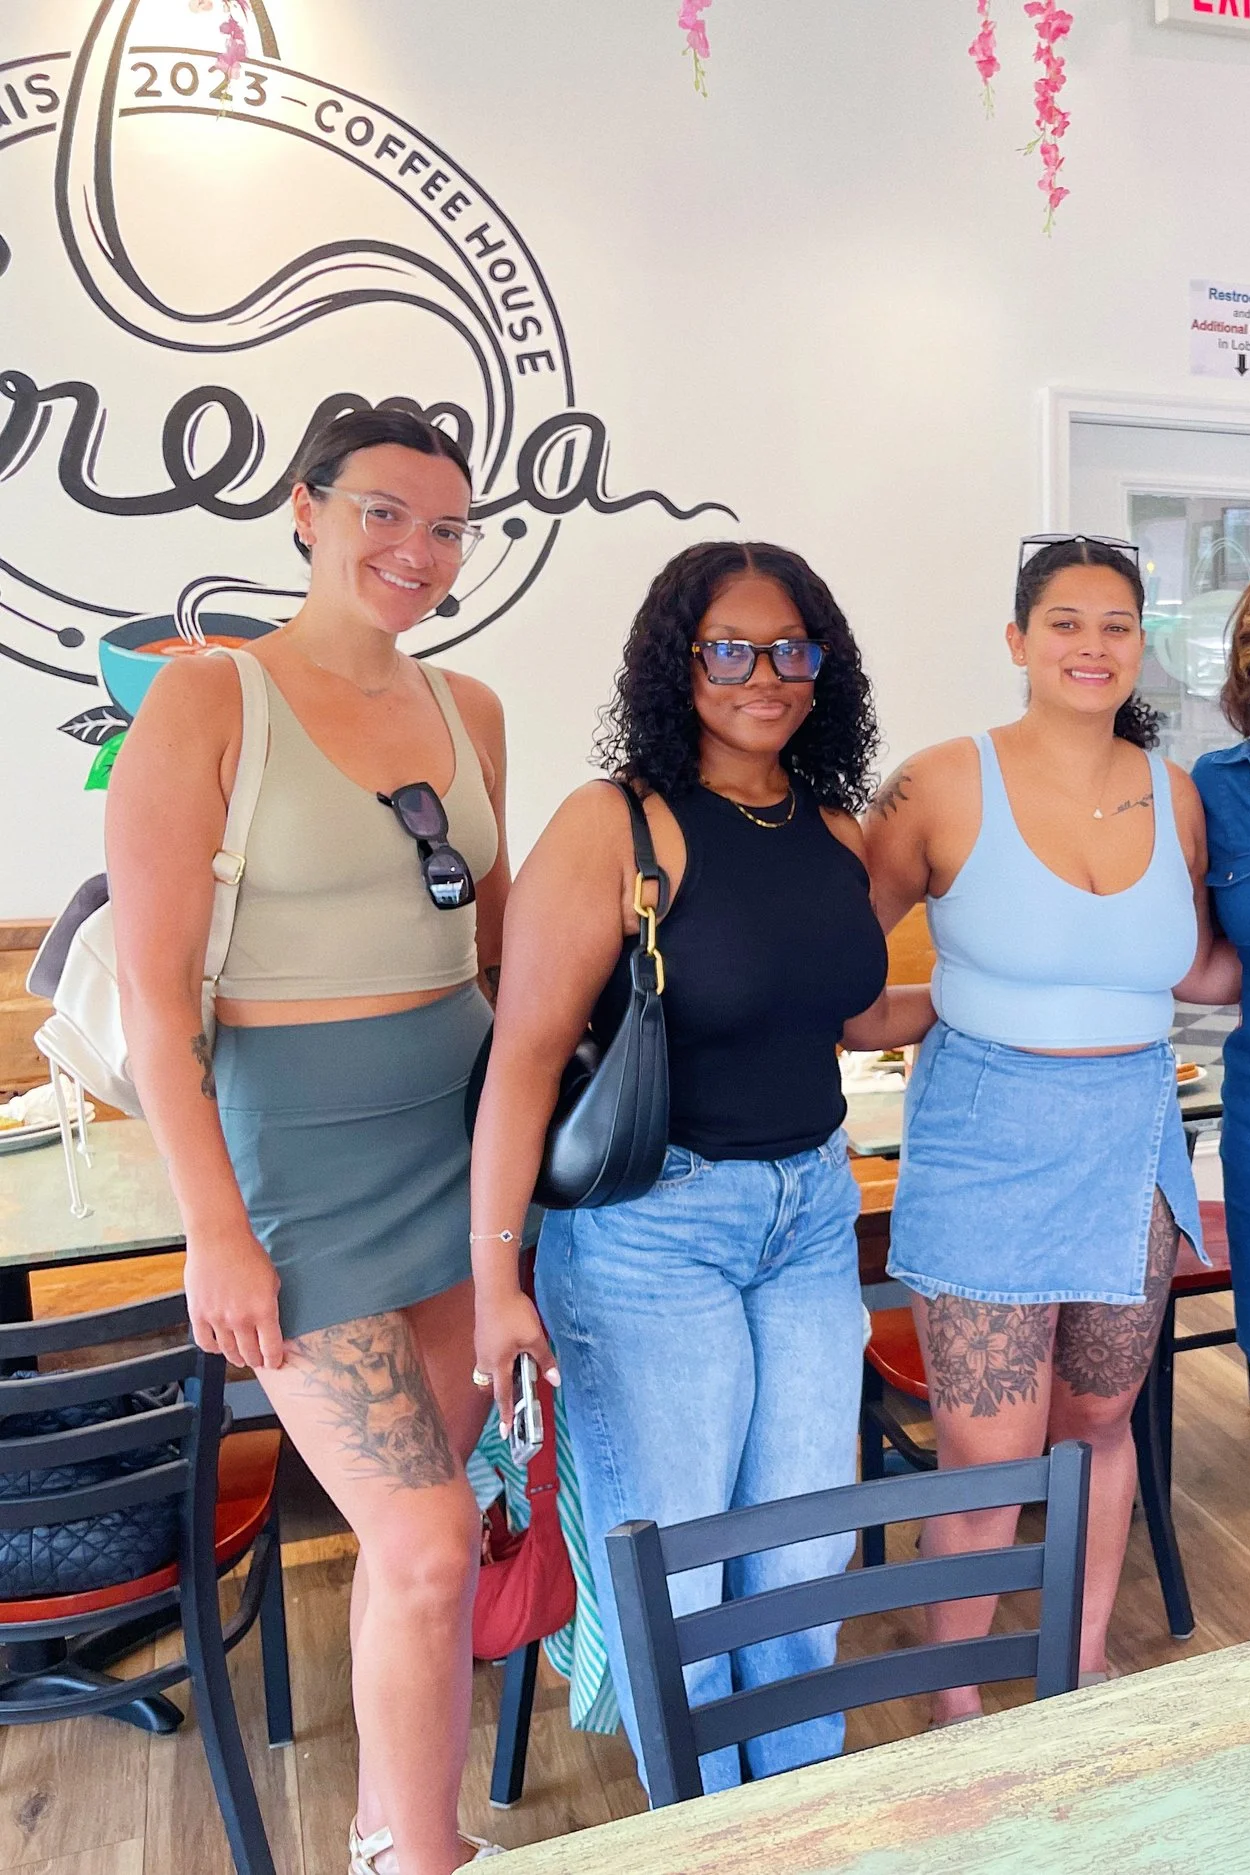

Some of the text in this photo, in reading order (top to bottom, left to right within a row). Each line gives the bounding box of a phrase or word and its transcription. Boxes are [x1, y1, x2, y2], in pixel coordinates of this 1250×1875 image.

[130, 61, 268, 107] 2023
[315, 99, 472, 222] COFFEE
[465, 222, 556, 376] HOUSE
[1191, 319, 1248, 335] Additional
[1218, 338, 1229, 349] in
